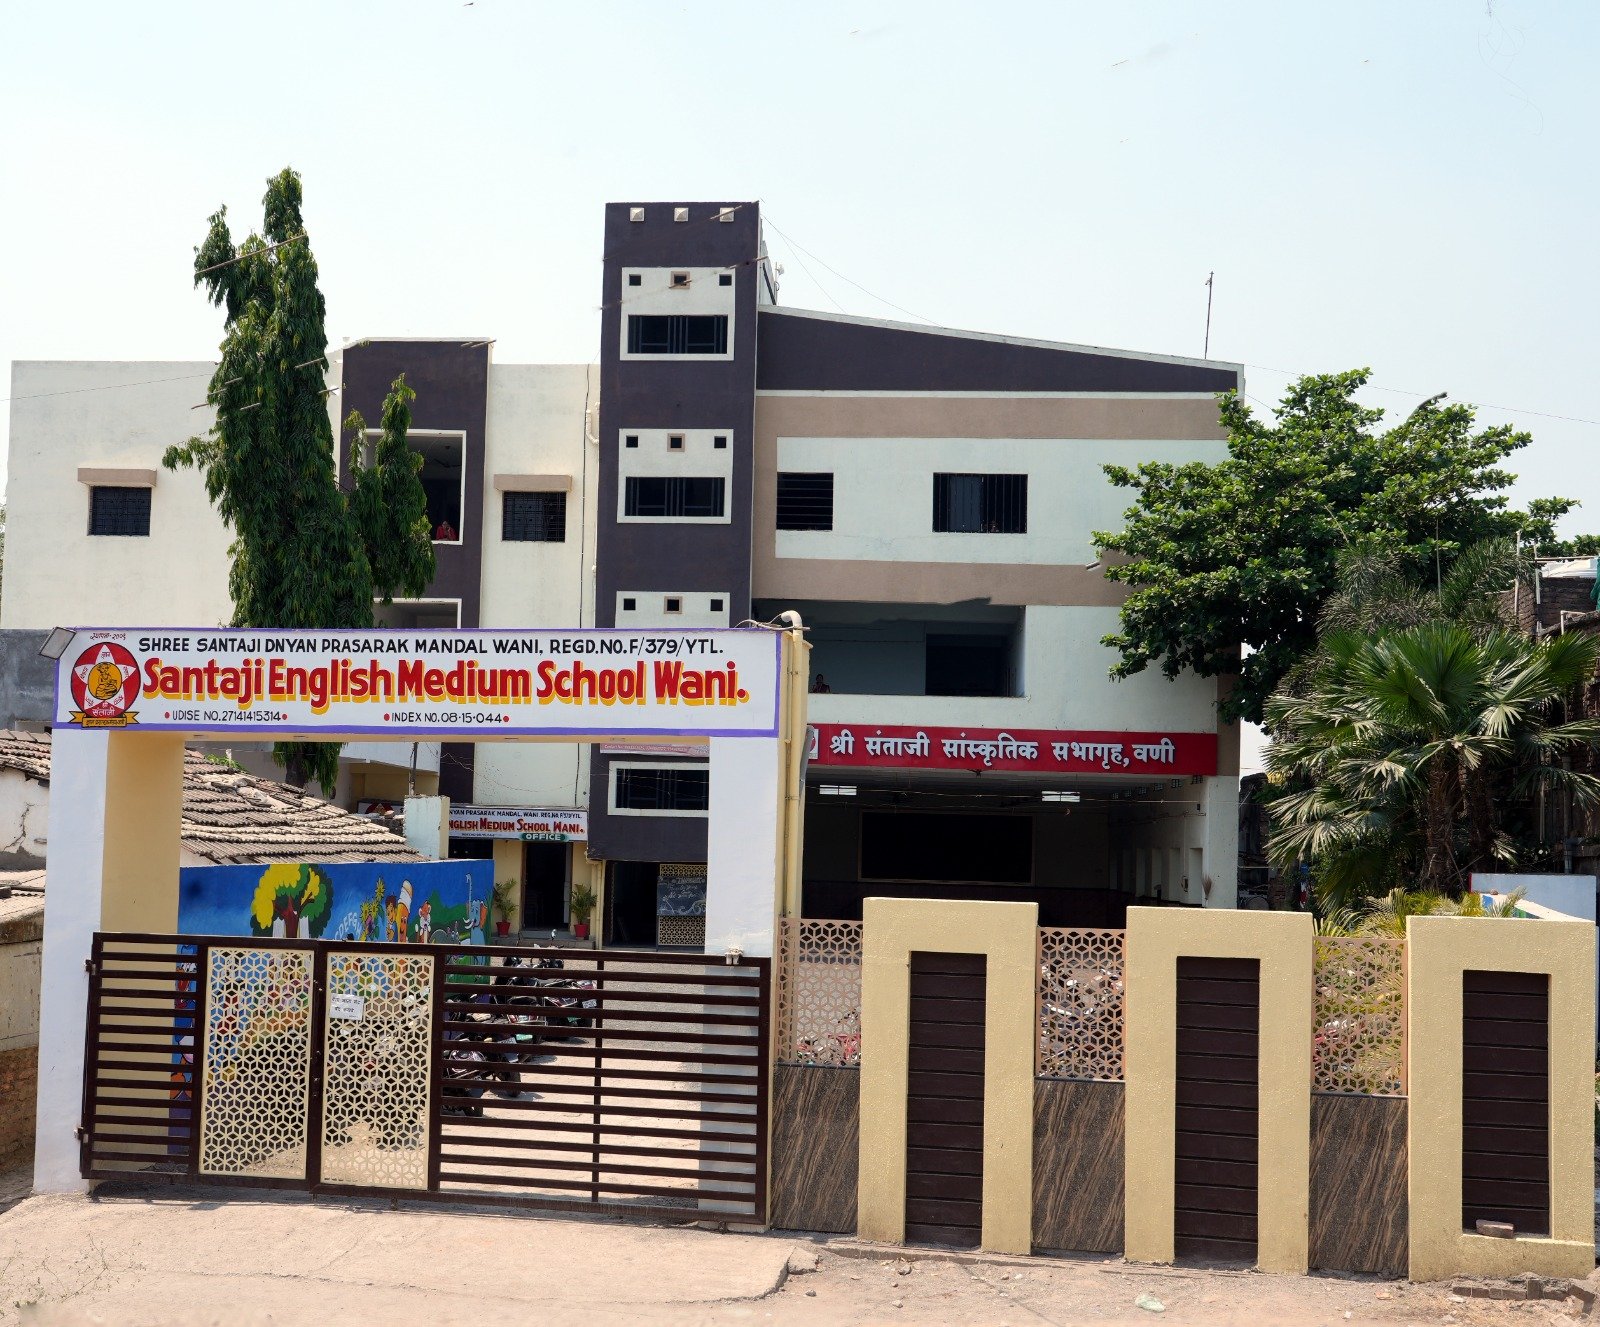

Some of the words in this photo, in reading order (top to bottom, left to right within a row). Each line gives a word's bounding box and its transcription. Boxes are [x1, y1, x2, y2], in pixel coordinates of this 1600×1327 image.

[138, 637, 190, 653] SHREE
[196, 637, 261, 653] SANTAJI
[265, 638, 317, 653] DNYAN
[321, 638, 409, 654] PRASARAK
[415, 638, 487, 654] MANDAL
[492, 638, 544, 656] WANI,
[142, 657, 265, 709] Santaji
[269, 657, 394, 714] English
[397, 658, 532, 704] Medium
[536, 659, 646, 706] School
[653, 659, 749, 706] Wani.
[172, 710, 200, 721] UDISE
[391, 711, 422, 723] INDEX
[829, 729, 855, 755] श्री
[864, 730, 930, 757] संताजी
[941, 732, 1038, 766] सांस्कृतिक
[1133, 737, 1175, 764] वणी
[449, 820, 479, 831] NGLISH
[480, 818, 515, 832] MEDIUM
[516, 818, 550, 833] SCHOOL
[525, 833, 561, 841] OFFICE
